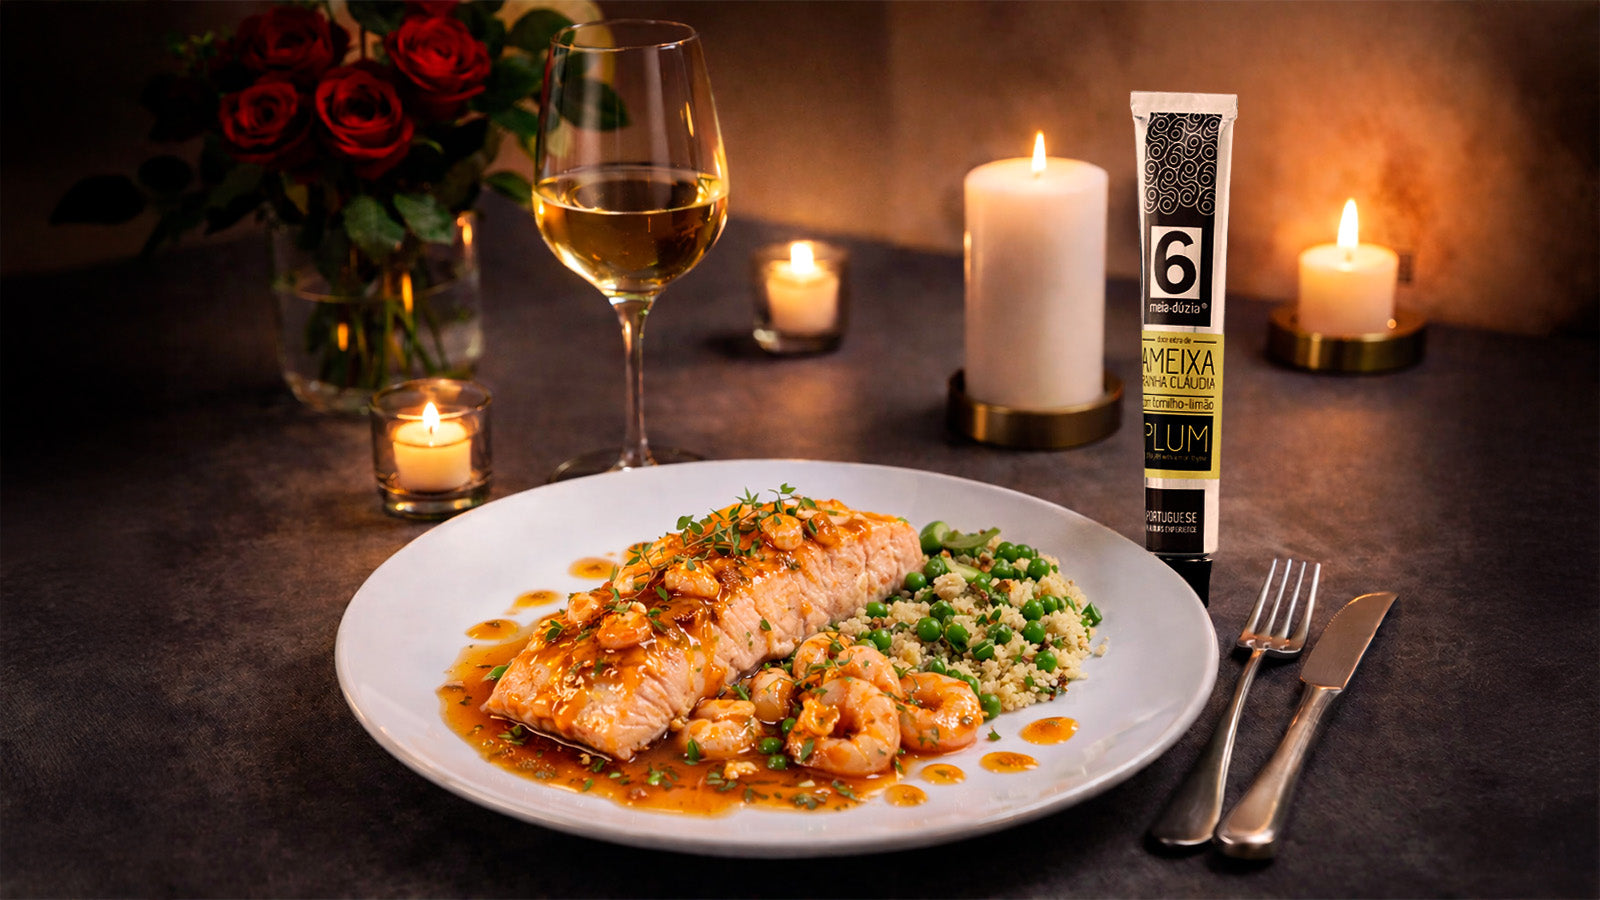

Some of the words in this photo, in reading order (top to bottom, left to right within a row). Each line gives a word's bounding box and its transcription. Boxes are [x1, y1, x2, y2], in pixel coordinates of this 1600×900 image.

[1154, 230, 1197, 295] 6
[1142, 347, 1215, 375] AMEIXA
[1169, 376, 1215, 390] CLÁUDIA
[1145, 422, 1208, 452] PLUM
[1146, 510, 1198, 523] PORTUGUESE
